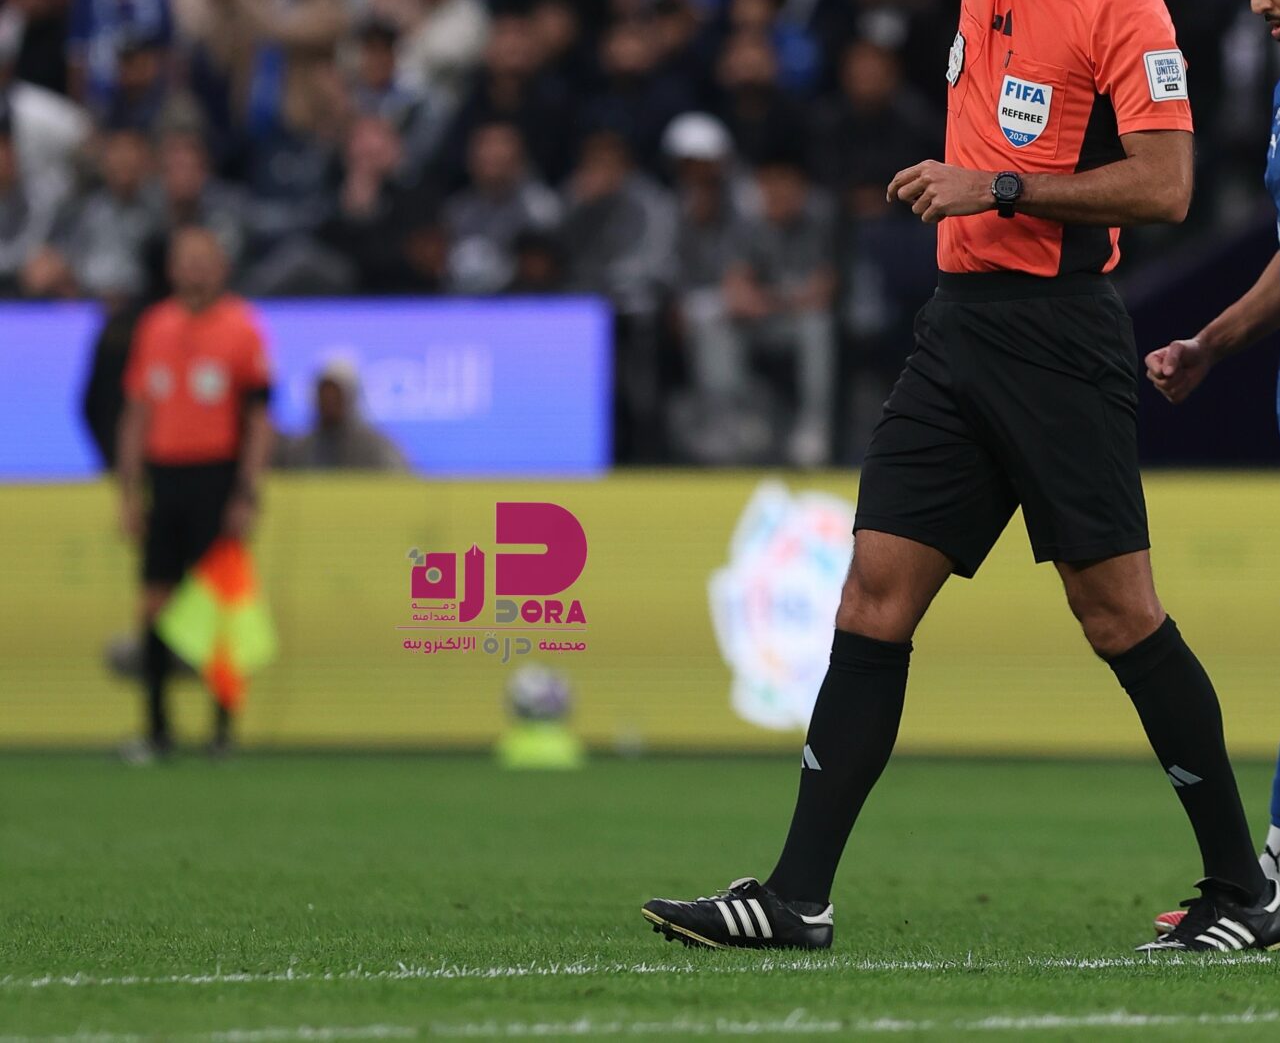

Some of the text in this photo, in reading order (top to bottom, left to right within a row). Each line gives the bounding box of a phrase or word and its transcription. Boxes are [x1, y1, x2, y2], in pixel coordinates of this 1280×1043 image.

[1156, 65, 1180, 76] UNITES
[1005, 80, 1046, 105] FIFA
[1001, 106, 1044, 124] REFEREE
[1009, 131, 1029, 143] 2026
